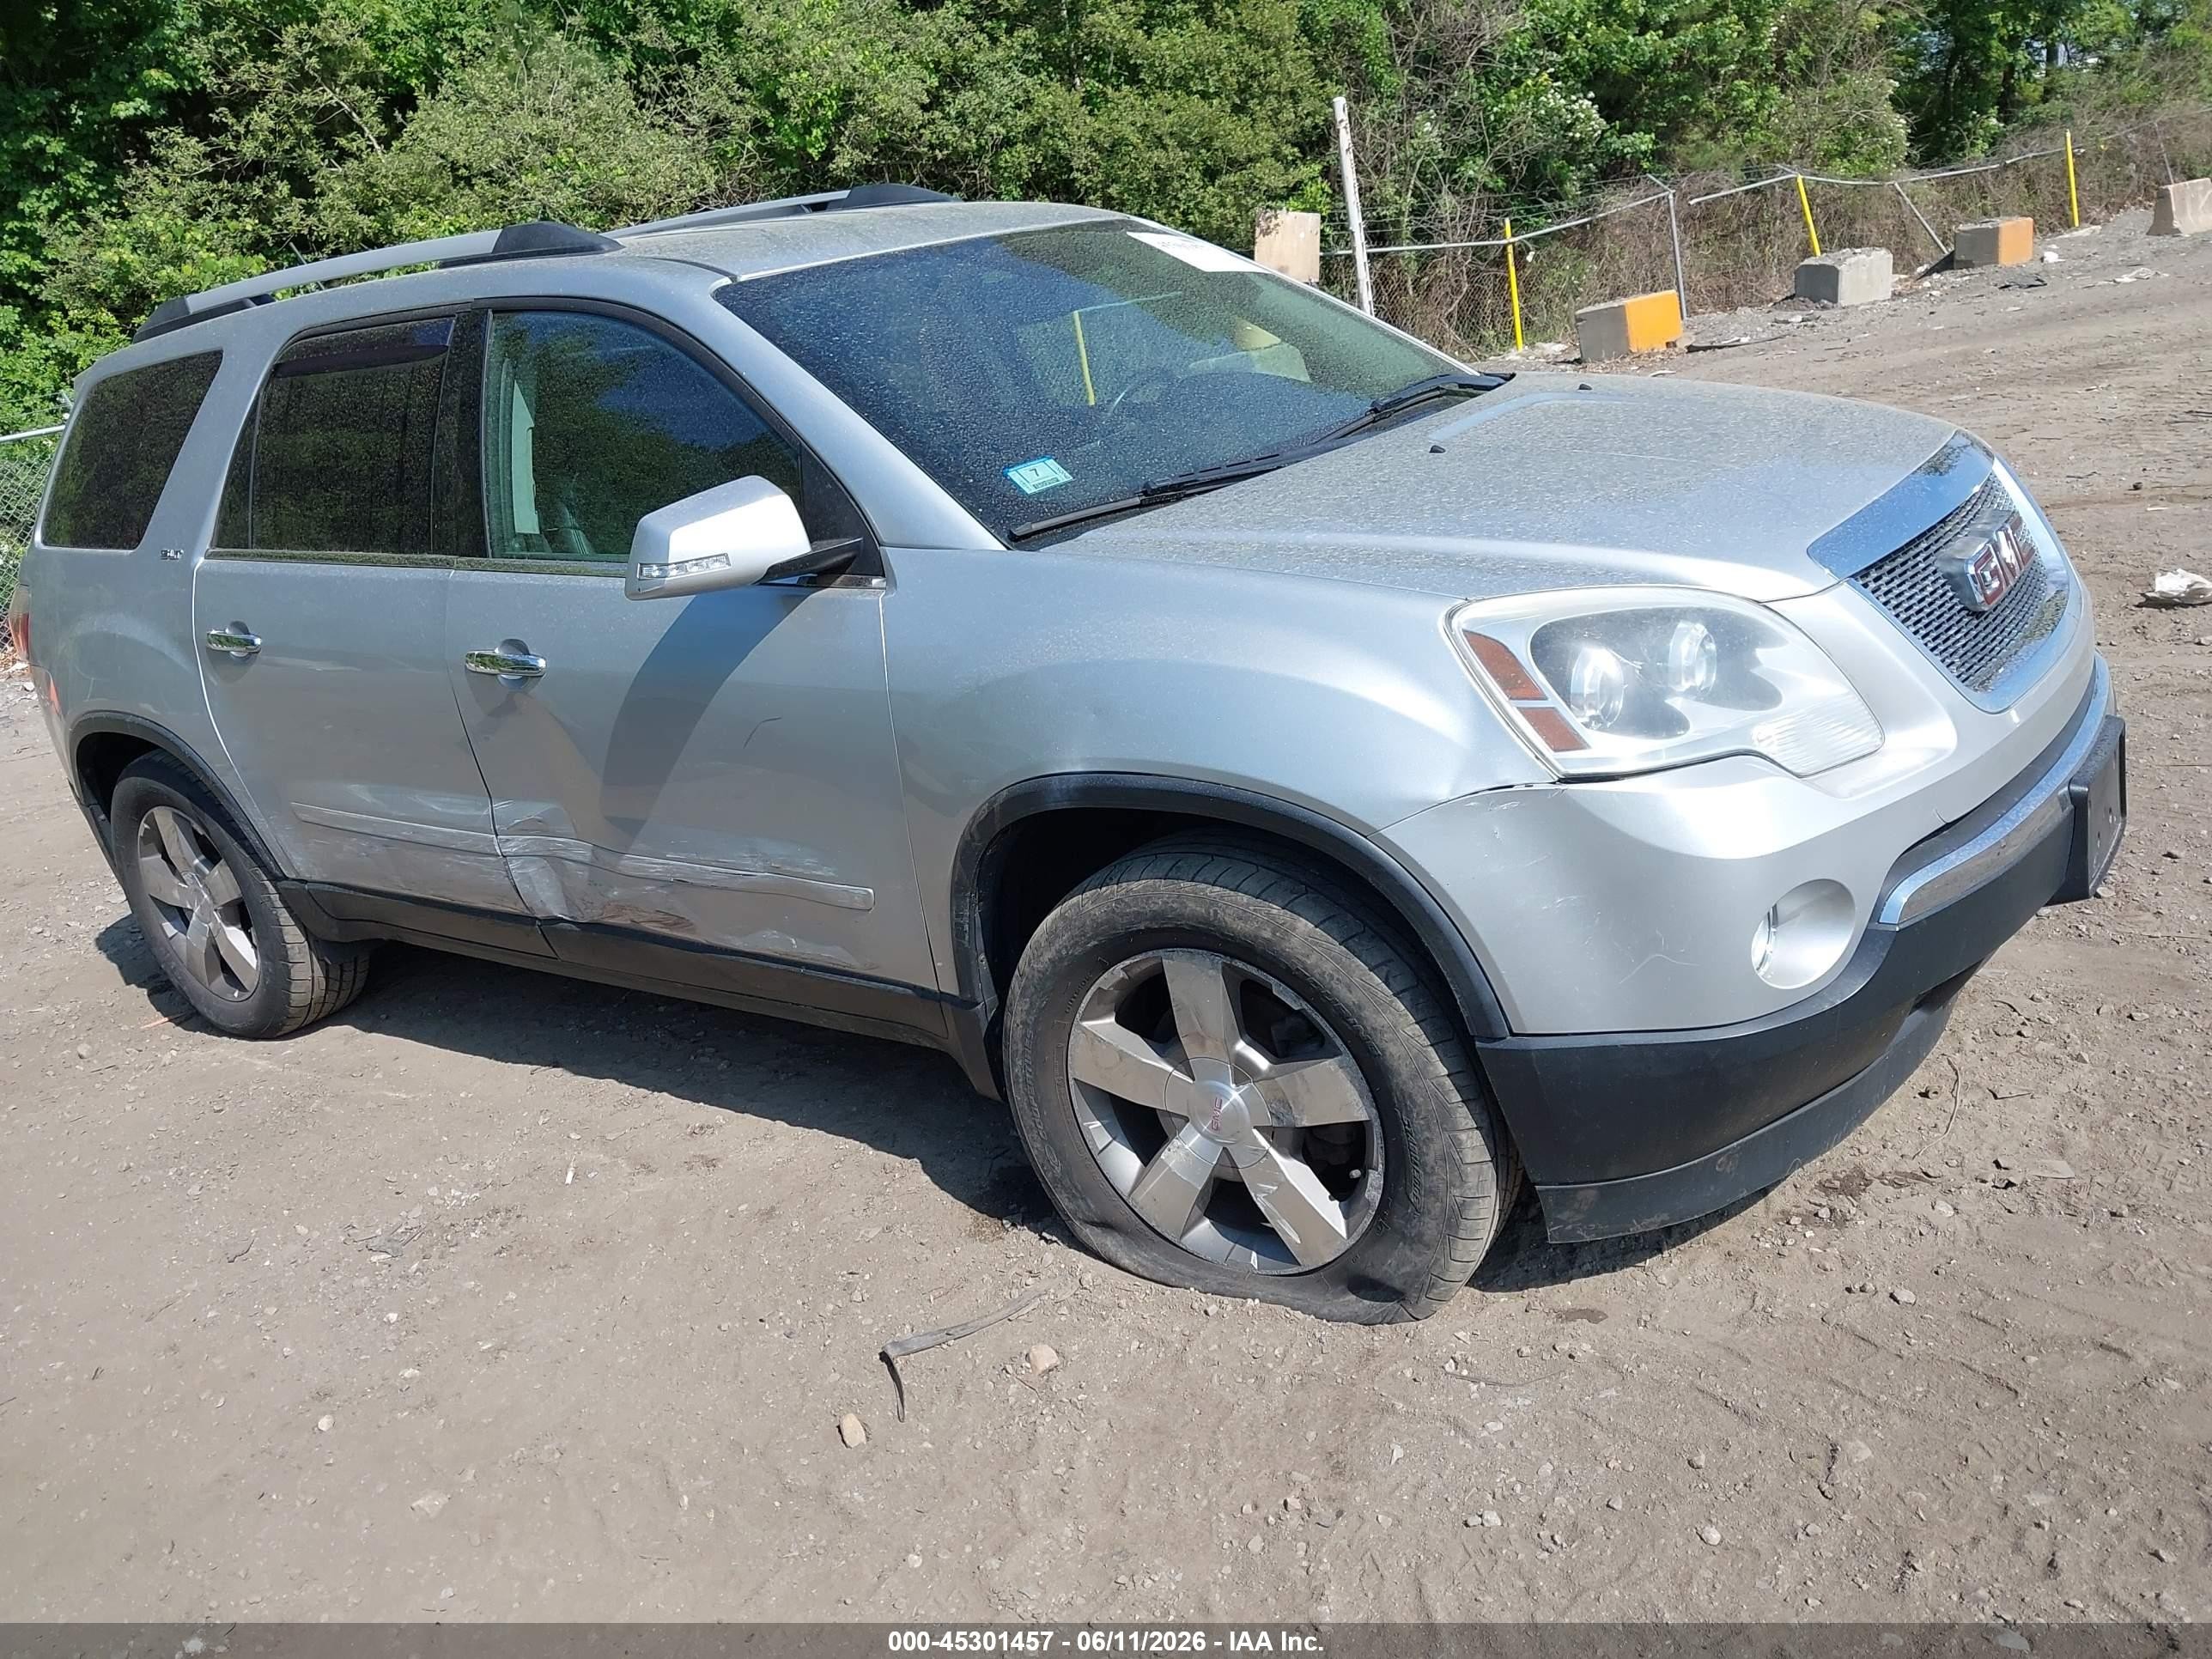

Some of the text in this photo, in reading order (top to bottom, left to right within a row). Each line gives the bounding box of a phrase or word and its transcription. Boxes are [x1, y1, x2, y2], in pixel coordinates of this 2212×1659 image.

[1029, 467, 1040, 477] 7
[1965, 511, 2036, 605] GMC
[1211, 1097, 1223, 1132] GMC
